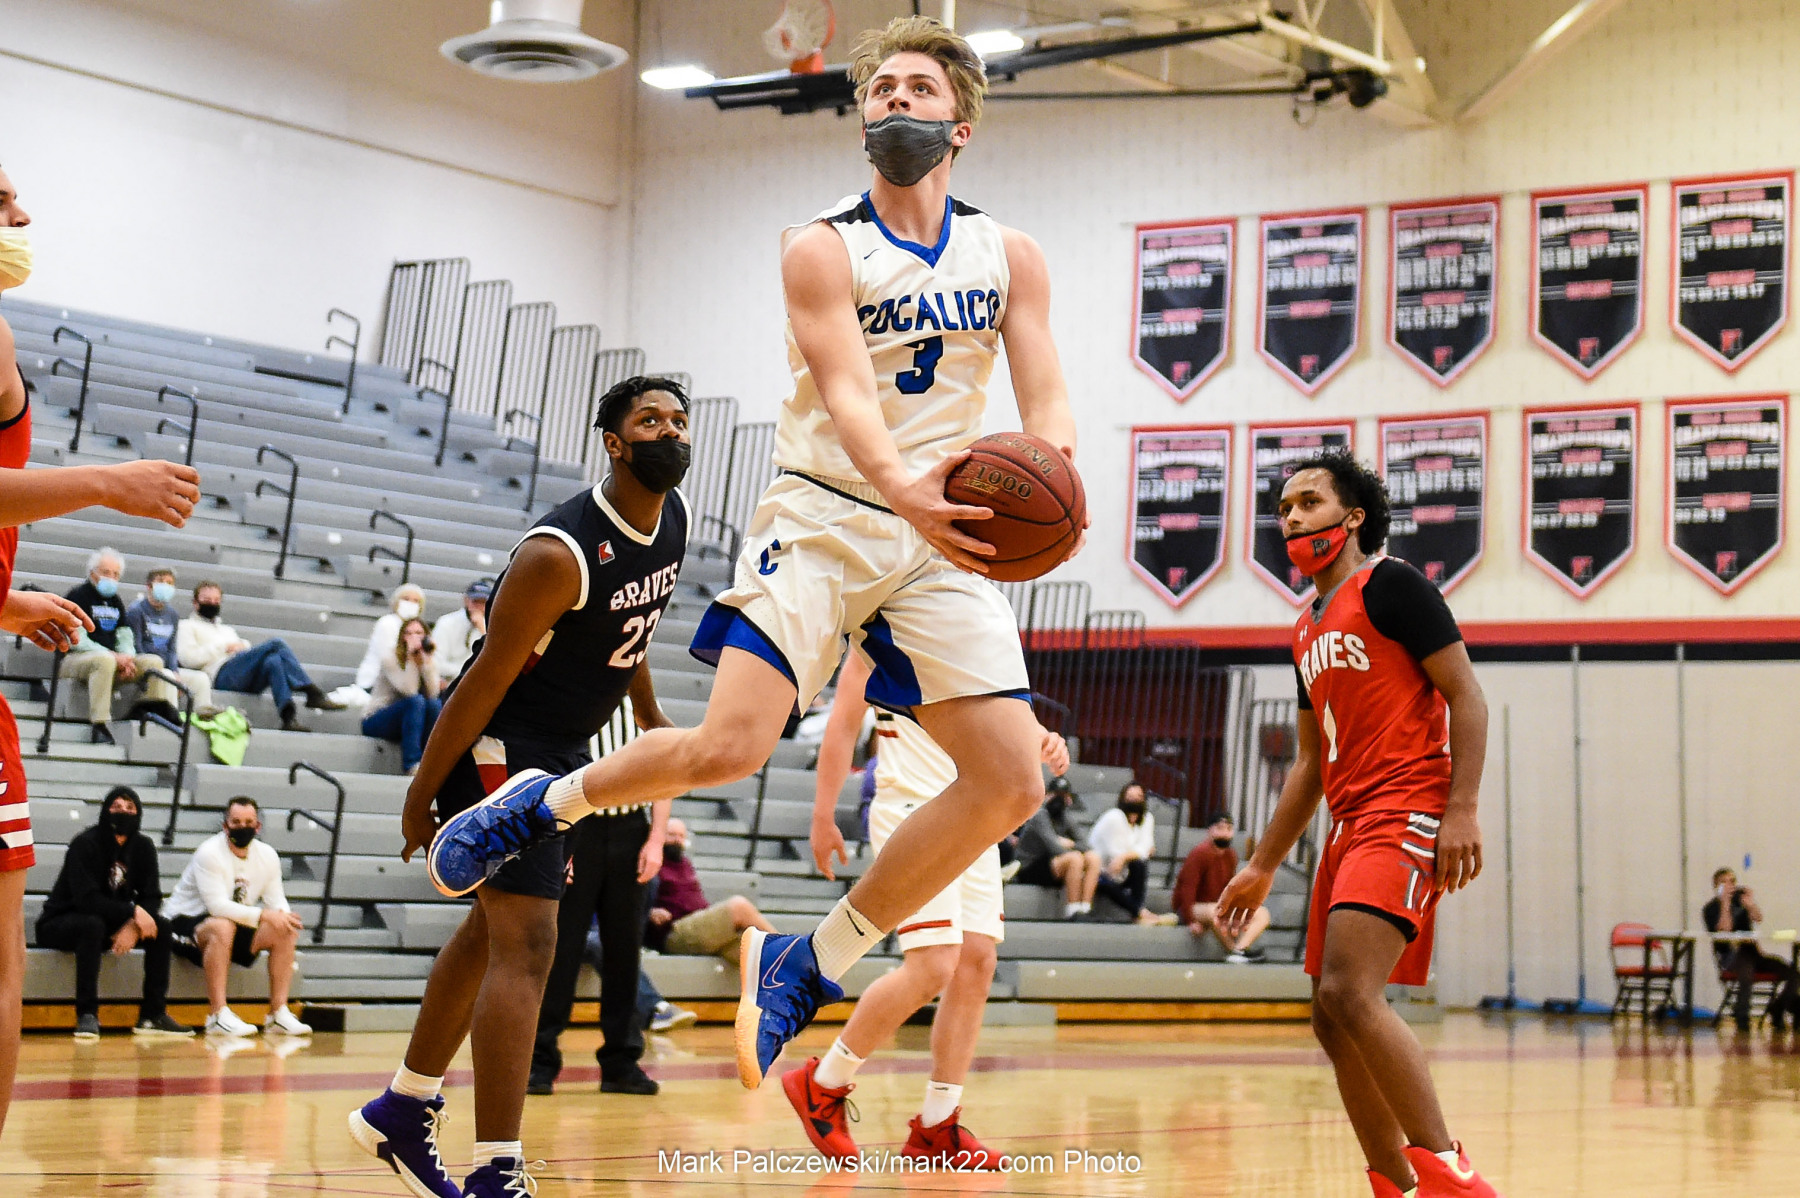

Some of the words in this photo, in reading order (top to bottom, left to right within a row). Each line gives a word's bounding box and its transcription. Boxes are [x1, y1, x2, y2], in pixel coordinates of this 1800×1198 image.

[895, 335, 944, 395] 3
[610, 561, 678, 611] BRAVES
[607, 608, 661, 669] 23
[1300, 630, 1371, 696] RAVES
